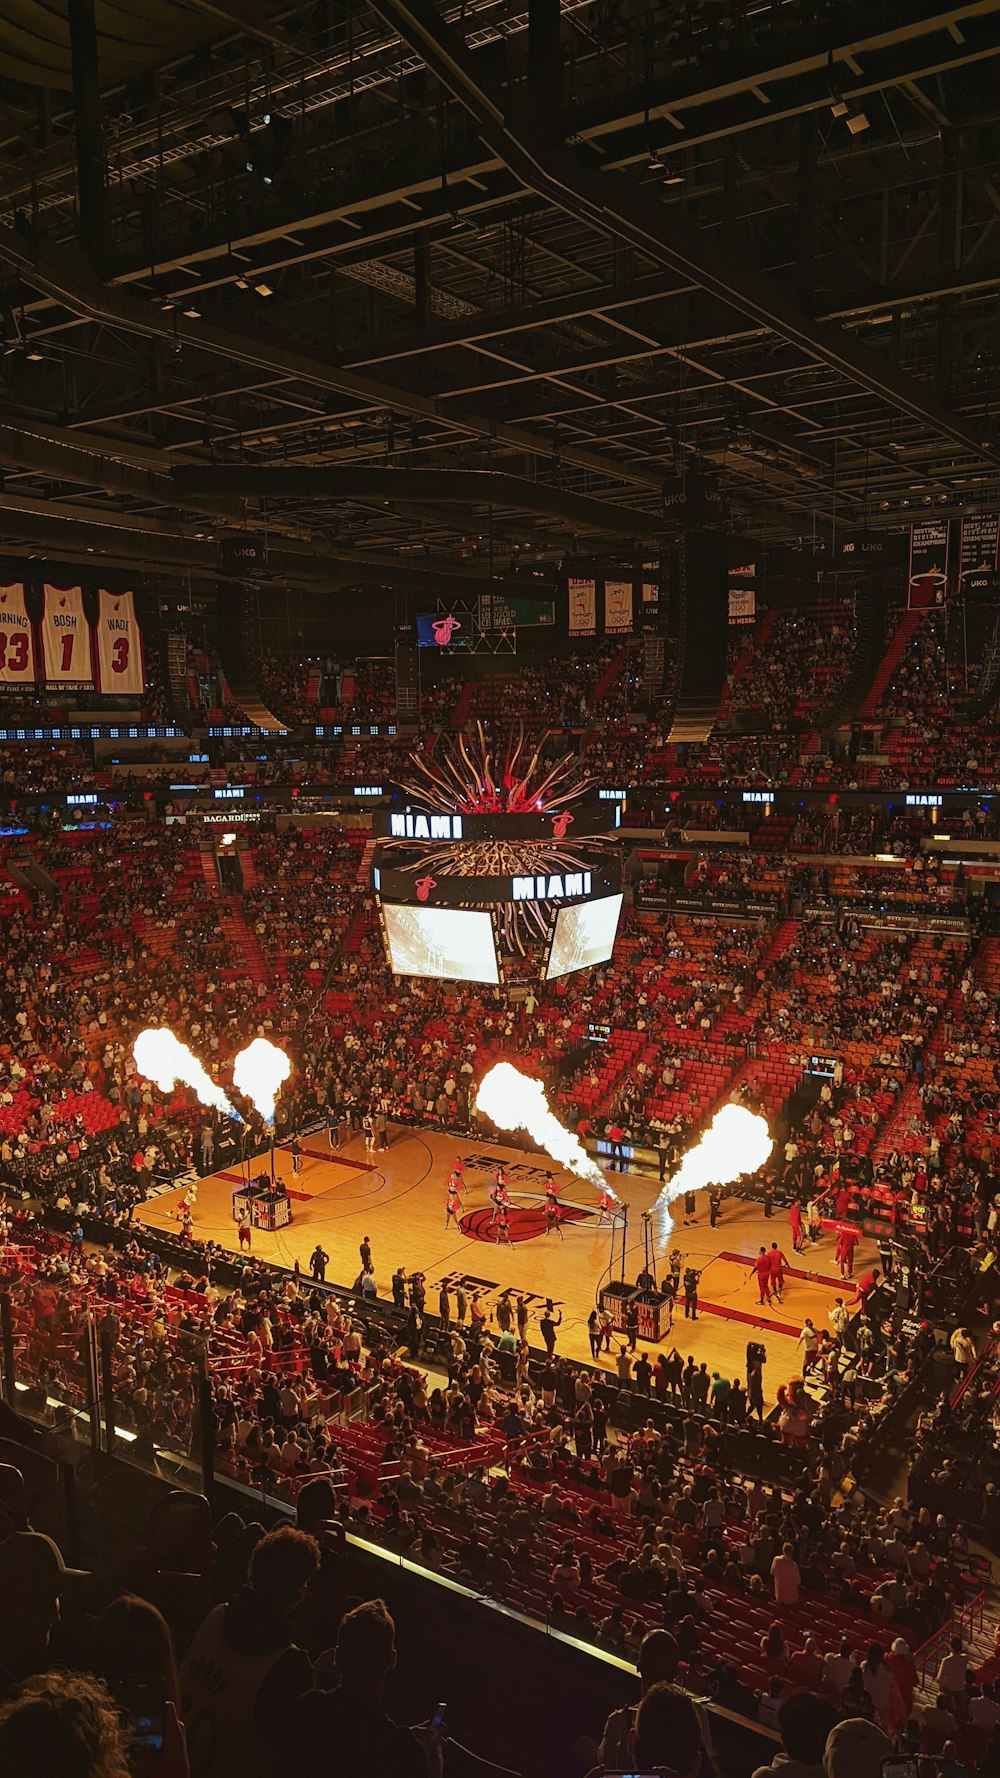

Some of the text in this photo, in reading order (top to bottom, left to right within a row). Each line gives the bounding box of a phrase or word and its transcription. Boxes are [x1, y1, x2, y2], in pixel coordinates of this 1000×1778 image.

[664, 493, 688, 506] UKG
[233, 548, 256, 557] UKG
[53, 615, 77, 628] BOSH
[107, 619, 129, 632] WADE
[61, 634, 74, 671] 1
[111, 637, 130, 673] 3
[213, 789, 245, 799] MIAMI
[353, 787, 383, 796] MIAMI
[599, 790, 627, 800] MIAMI
[742, 792, 775, 803] MIAMI
[66, 794, 99, 805] MIAMI
[905, 795, 943, 806] MIAMI
[390, 813, 463, 839] MIAMI
[512, 872, 592, 901] MIAMI
[508, 1164, 561, 1178] FTX
[498, 1288, 566, 1312] FTX
